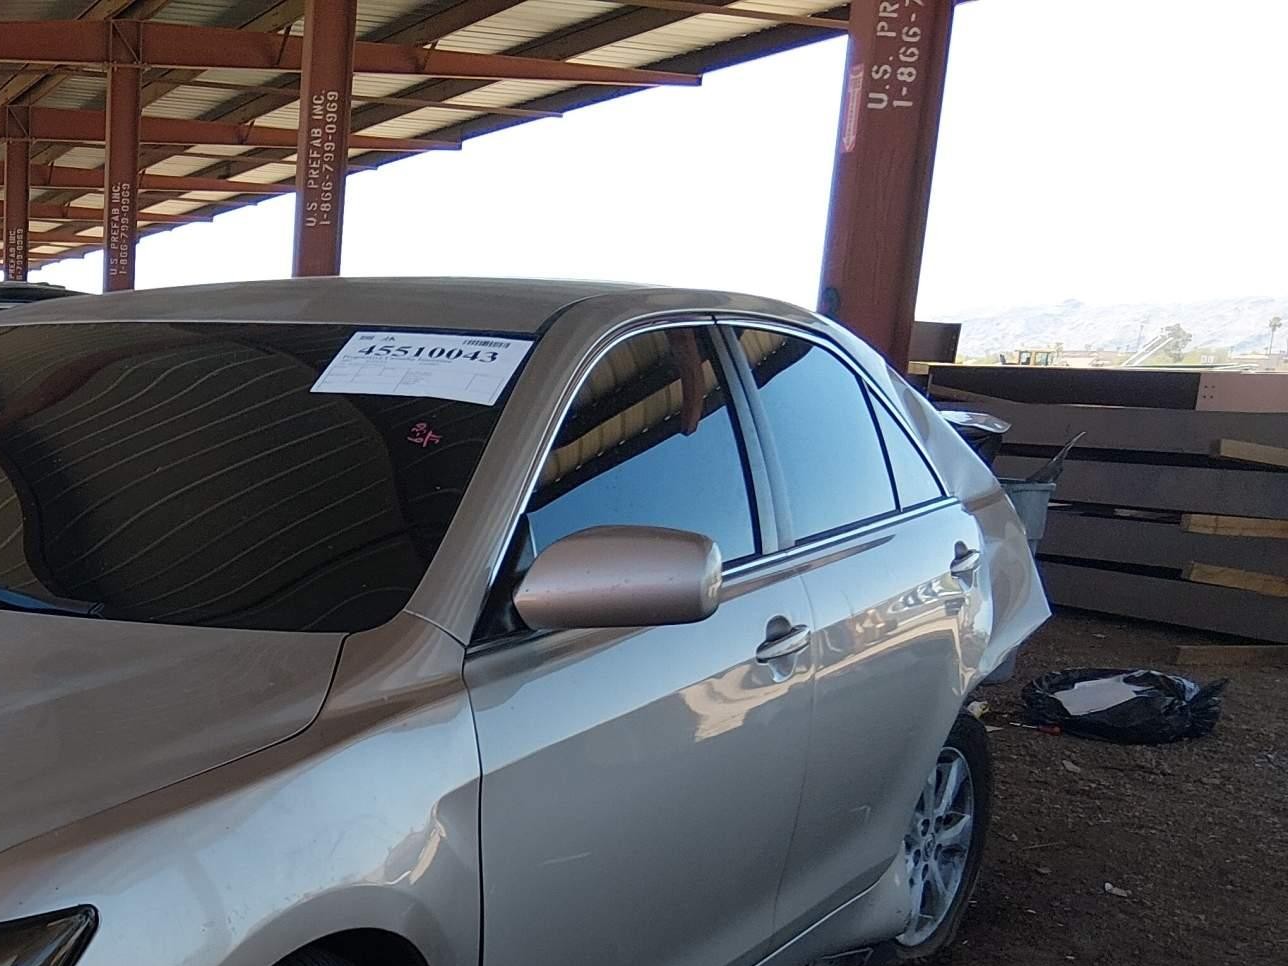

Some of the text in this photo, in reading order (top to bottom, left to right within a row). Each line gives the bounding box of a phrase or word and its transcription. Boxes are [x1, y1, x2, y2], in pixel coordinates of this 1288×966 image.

[867, 1, 900, 109] U.S. PR
[312, 90, 325, 119] INC.
[307, 128, 322, 188] PREFAB
[320, 91, 339, 225] 1-866-799-0969
[110, 208, 120, 249] PREFAB
[358, 345, 498, 363] 45510043
